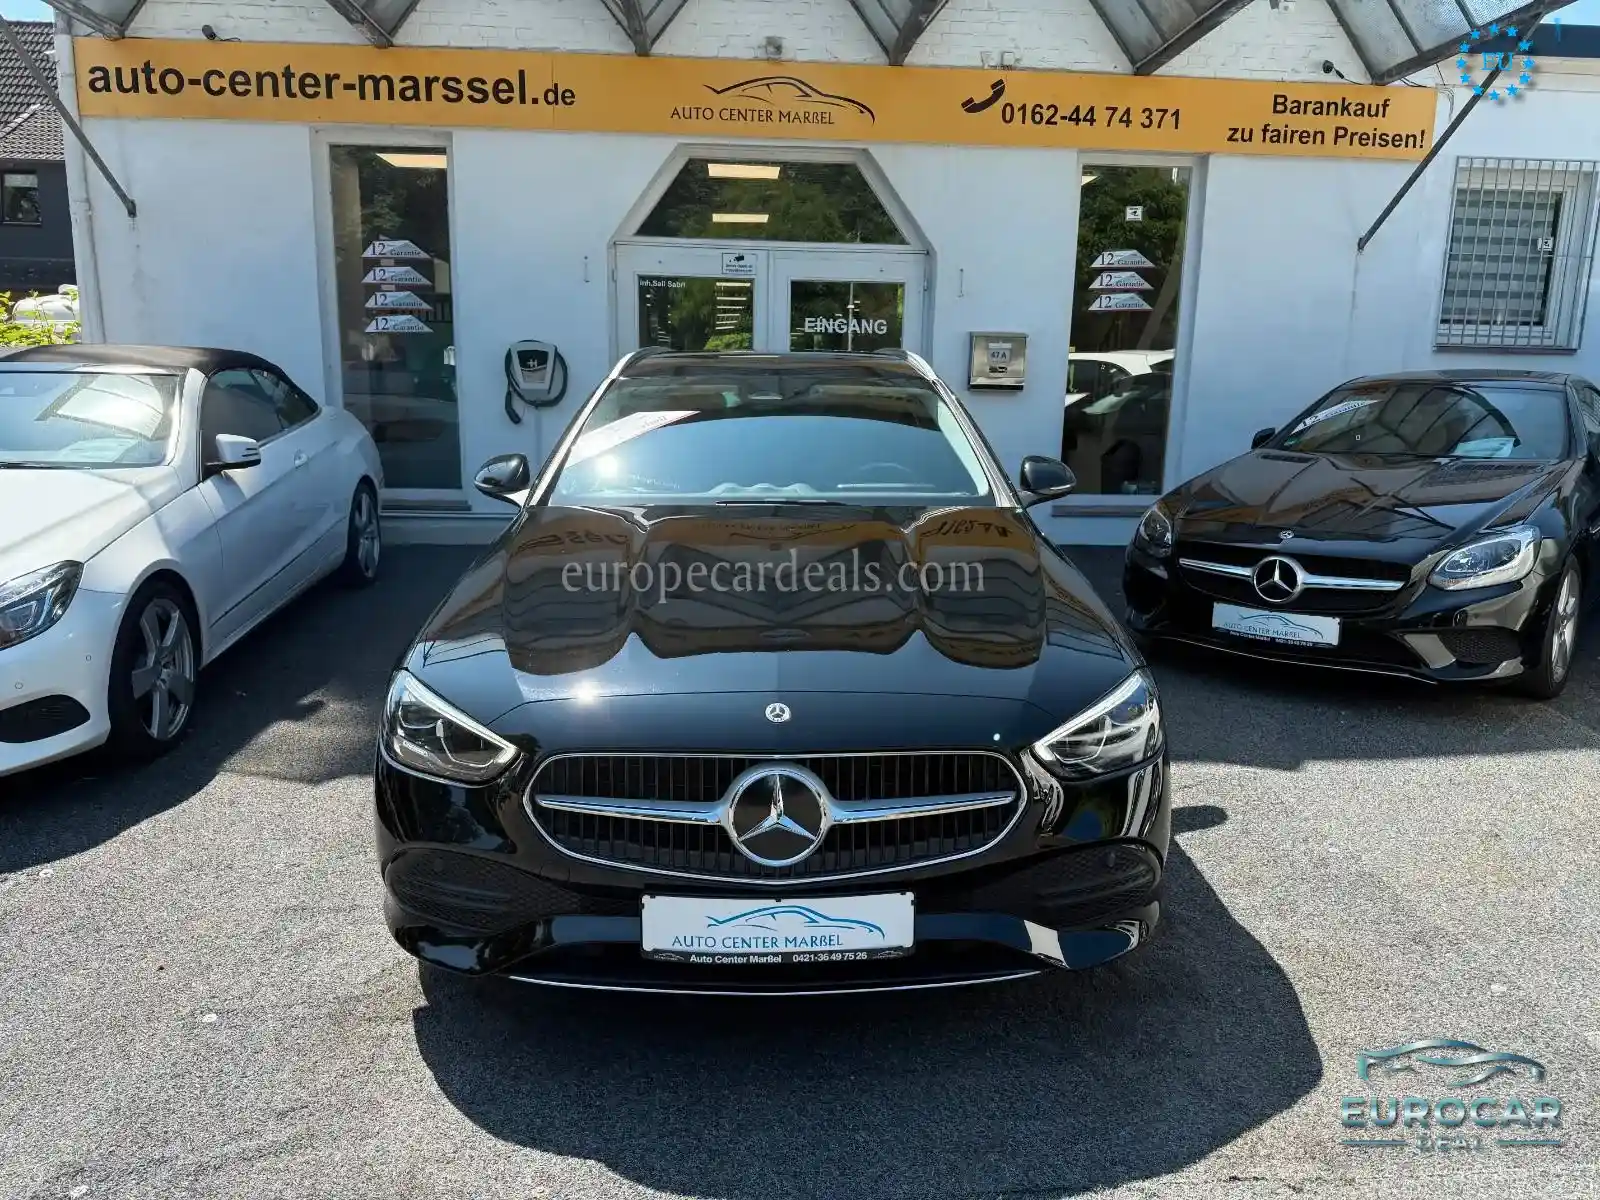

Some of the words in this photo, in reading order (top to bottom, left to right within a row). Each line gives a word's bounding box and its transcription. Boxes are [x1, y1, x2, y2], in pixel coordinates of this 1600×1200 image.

[88, 59, 577, 107] auto-center-marssel.de
[1272, 94, 1391, 118] Barankauf
[670, 106, 715, 120] AUTO
[719, 107, 774, 123] CENTER
[1001, 102, 1097, 127] 0162-44
[1105, 106, 1133, 129] 74
[1140, 107, 1181, 130] 371
[1226, 126, 1254, 143] zu
[1261, 123, 1326, 145] fairen
[1333, 126, 1426, 149] Preisen!
[370, 242, 387, 256] 12
[1099, 252, 1115, 266] 12
[372, 268, 387, 282] 12
[1098, 273, 1113, 287] 12
[373, 293, 389, 306] 12
[1097, 295, 1112, 309] 12
[373, 317, 390, 331] 12
[803, 317, 888, 335] EINGANG
[671, 935, 717, 949] AUTO
[722, 936, 779, 949] CENTER
[689, 954, 713, 964] Auto
[716, 955, 747, 965] Center
